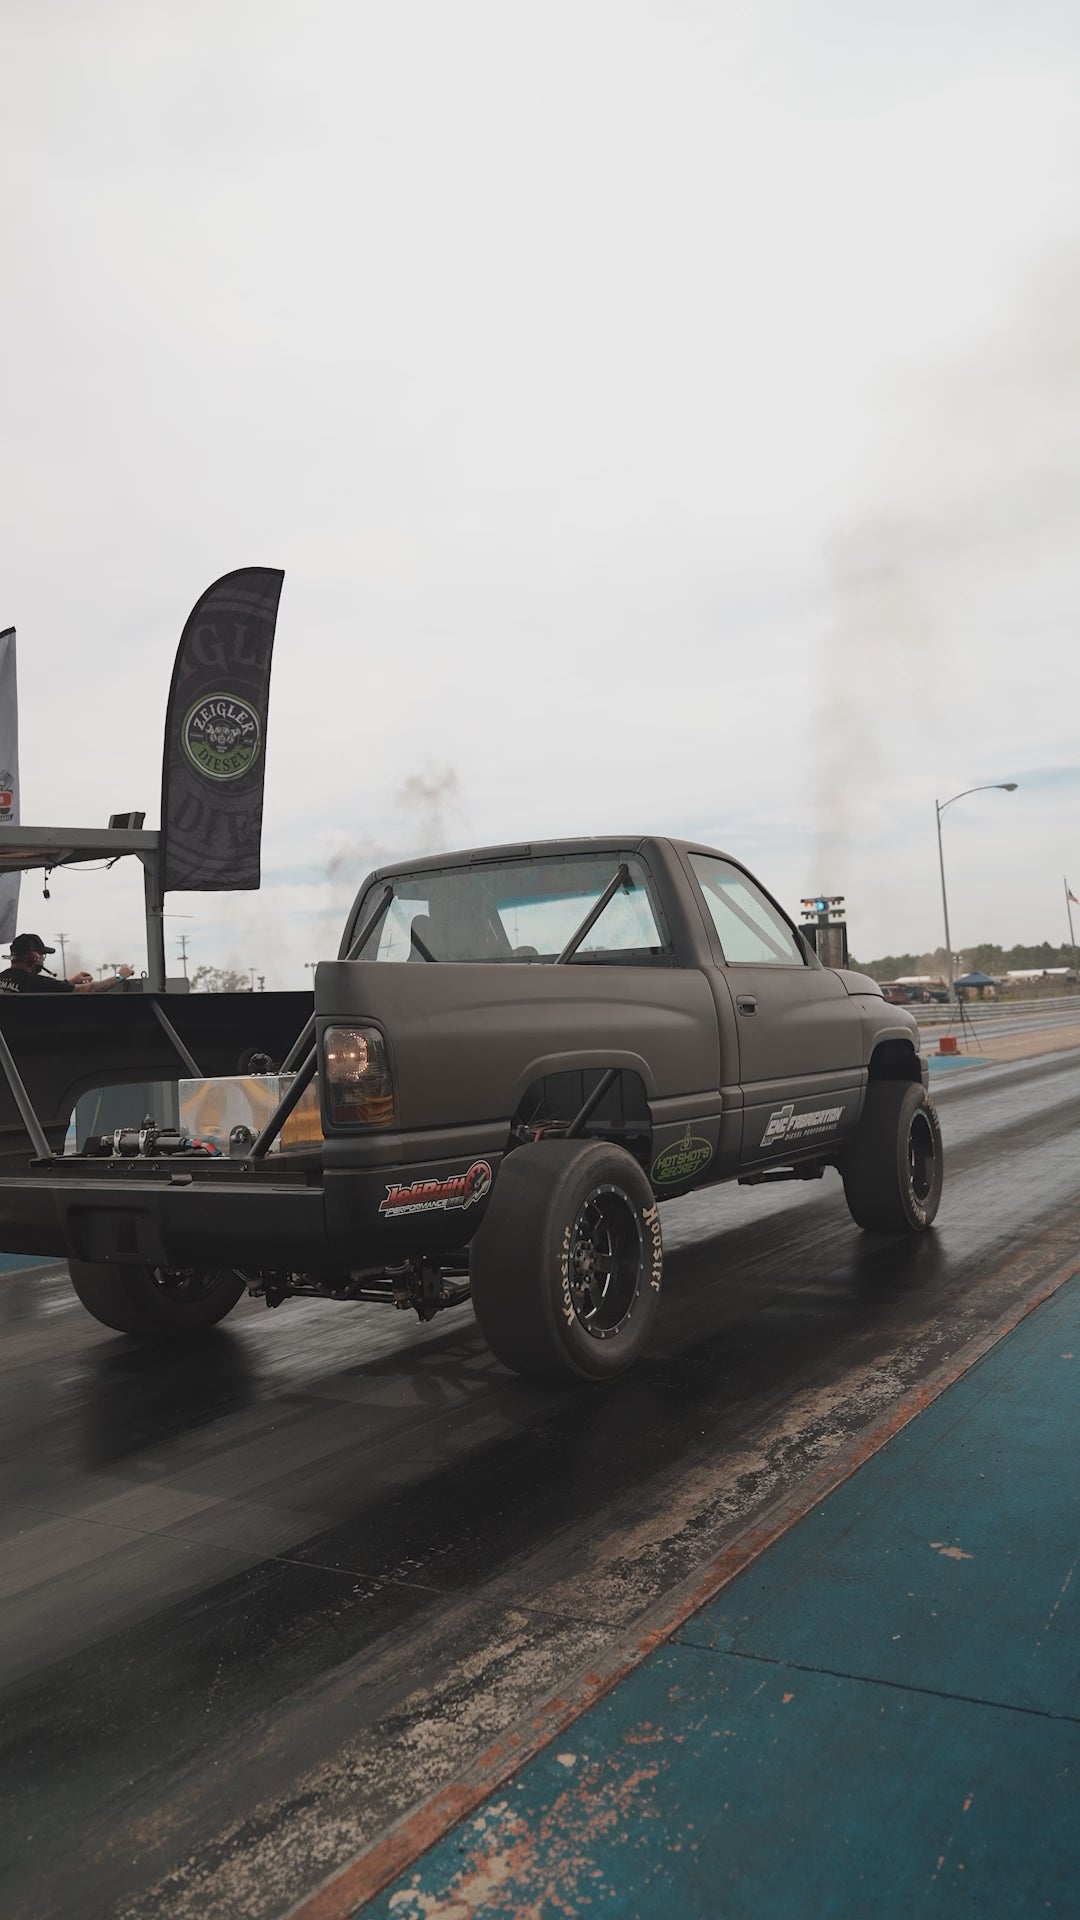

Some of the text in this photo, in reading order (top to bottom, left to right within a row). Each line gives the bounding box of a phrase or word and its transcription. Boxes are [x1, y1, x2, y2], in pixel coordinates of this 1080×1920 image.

[193, 702, 254, 736] ZEIGLER
[198, 748, 249, 771] DIESEL
[787, 1106, 843, 1131] FABRICATION
[658, 1160, 702, 1180] SECRET
[386, 1198, 448, 1215] PERFORMANCE
[642, 1202, 662, 1292] Hoosier
[561, 1226, 576, 1326] Hoosier
